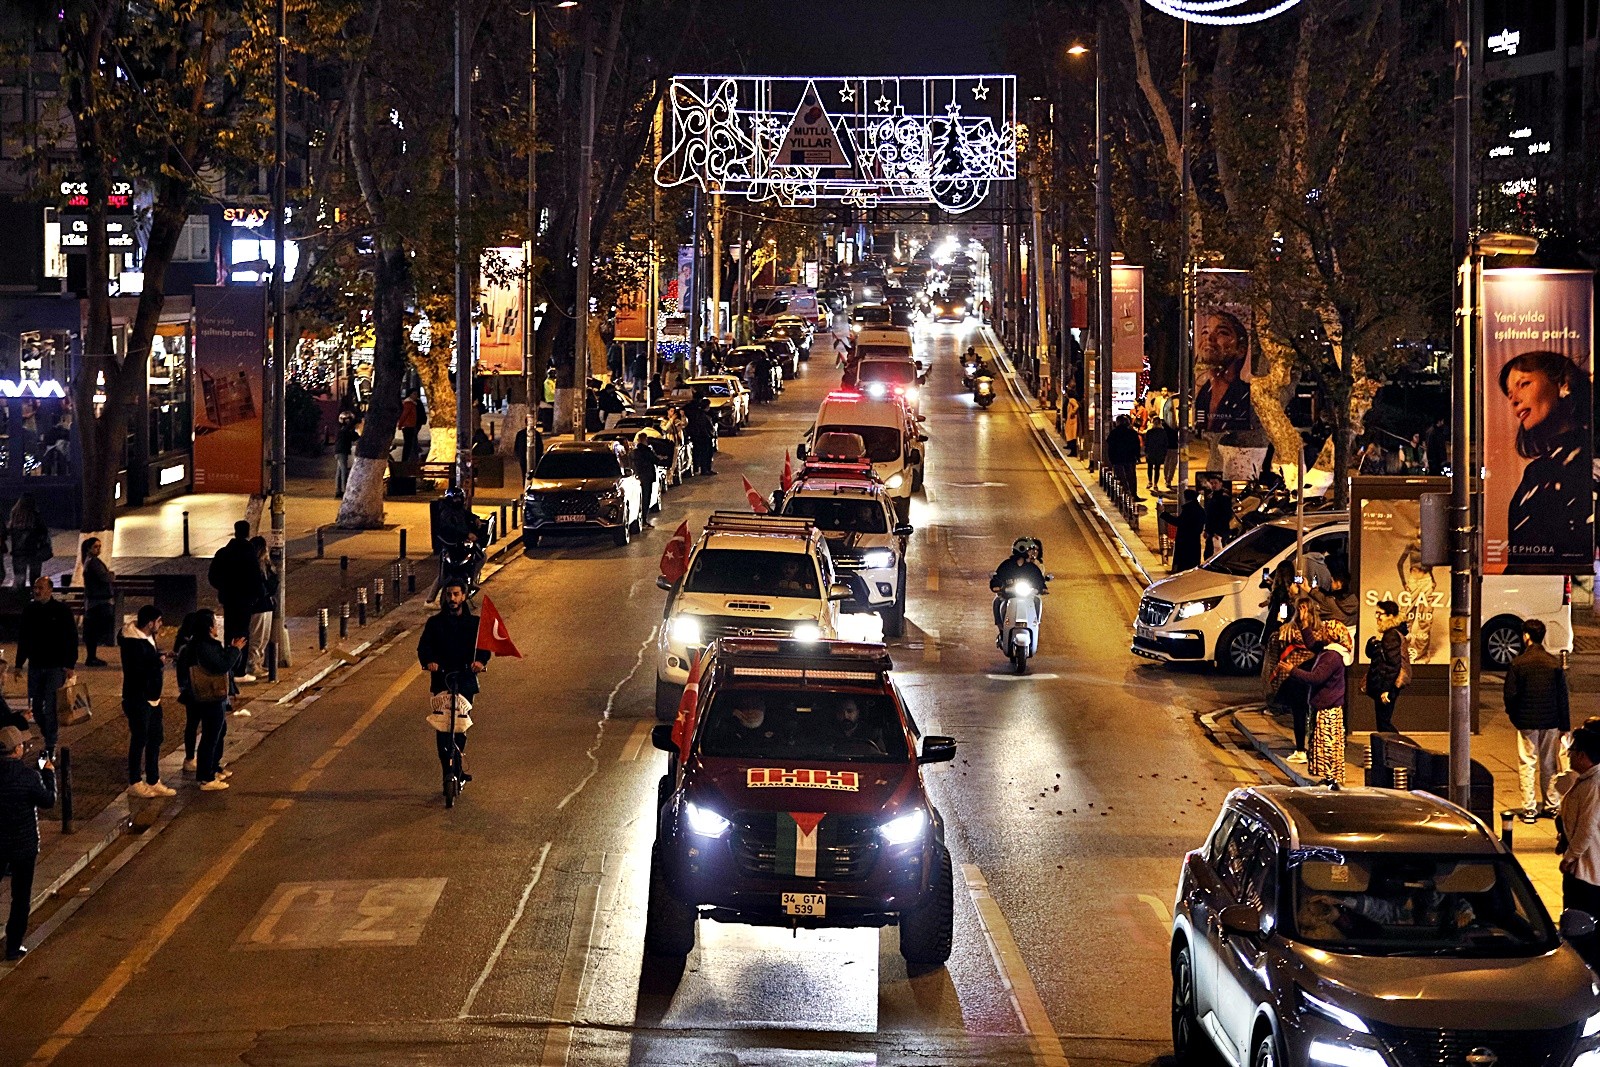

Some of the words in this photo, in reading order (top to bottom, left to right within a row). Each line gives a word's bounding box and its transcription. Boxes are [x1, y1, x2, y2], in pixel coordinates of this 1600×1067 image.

[794, 127, 828, 135] MUTLU
[790, 138, 832, 148] YILLAR
[223, 208, 269, 221] STAY
[1494, 311, 1516, 323] Yeni
[1519, 309, 1545, 326] yılda
[1542, 327, 1580, 342] parla.
[783, 894, 796, 904] 34
[803, 894, 825, 904] GTA
[794, 904, 813, 914] 539
